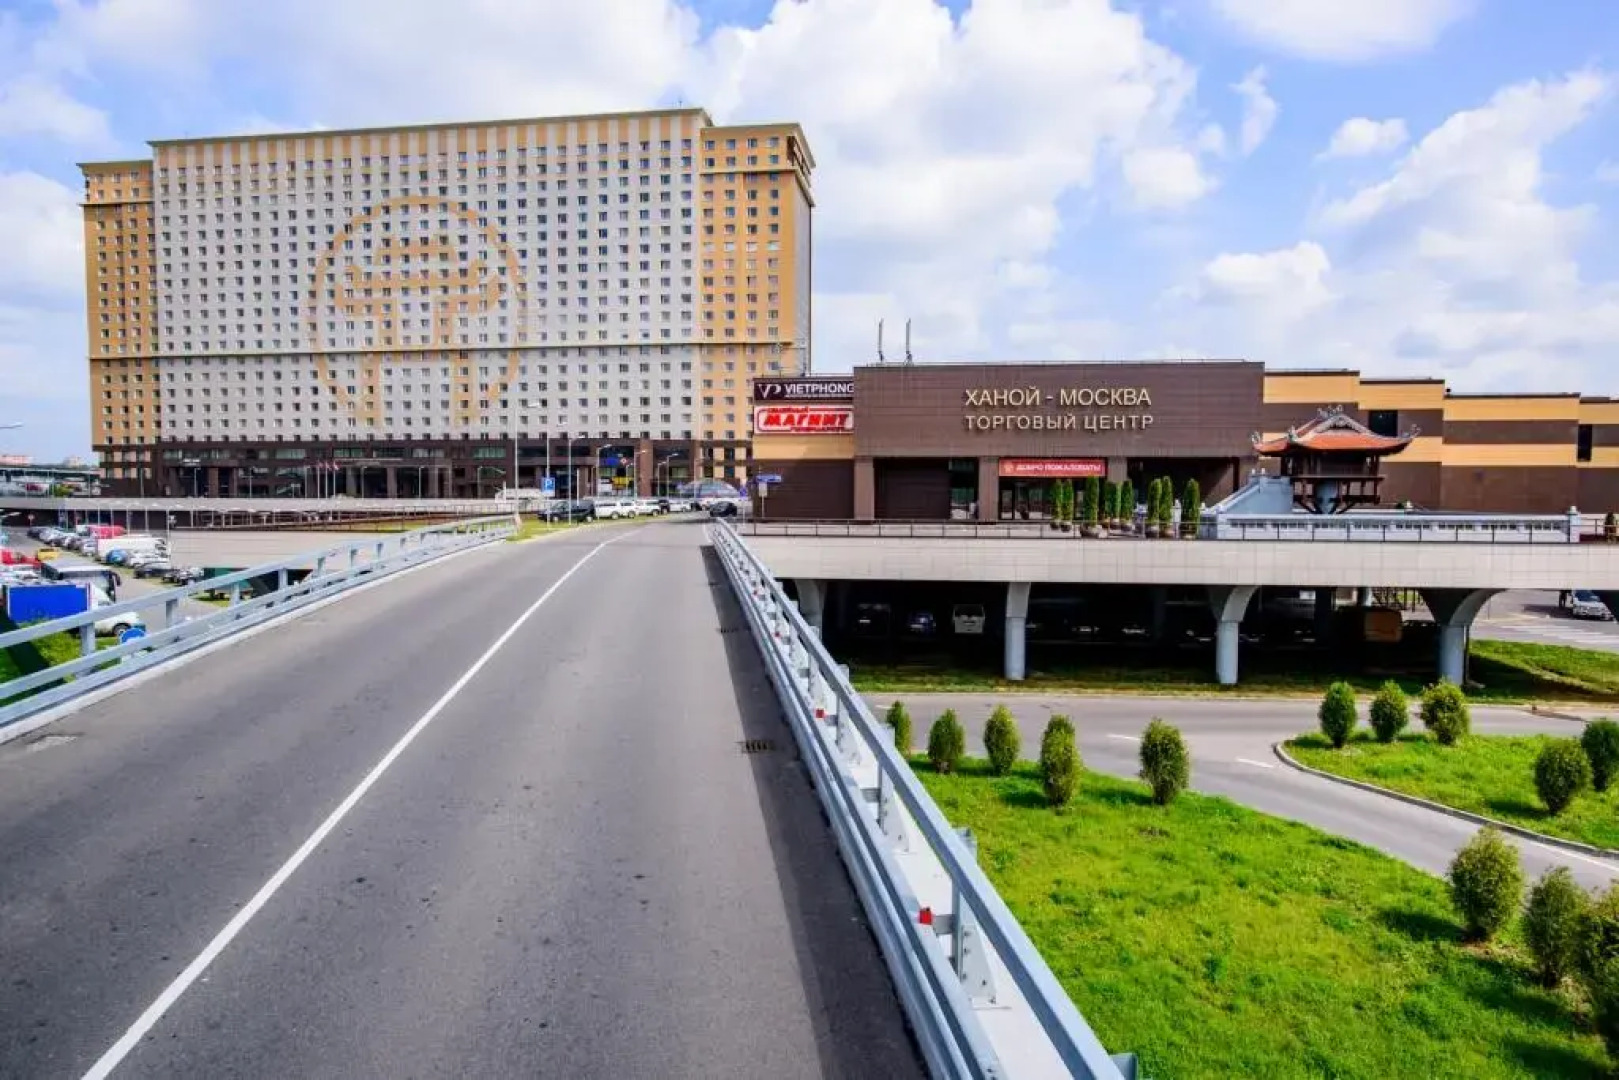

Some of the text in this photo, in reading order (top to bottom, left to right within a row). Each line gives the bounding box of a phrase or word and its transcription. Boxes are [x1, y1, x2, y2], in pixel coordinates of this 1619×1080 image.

[965, 386, 1040, 406] ХАНОЙ
[1060, 388, 1152, 406] МОСКВА
[763, 413, 849, 426] МАГНИТ
[965, 413, 1154, 432] ТОРГОВЫЙ ЦЕНТР
